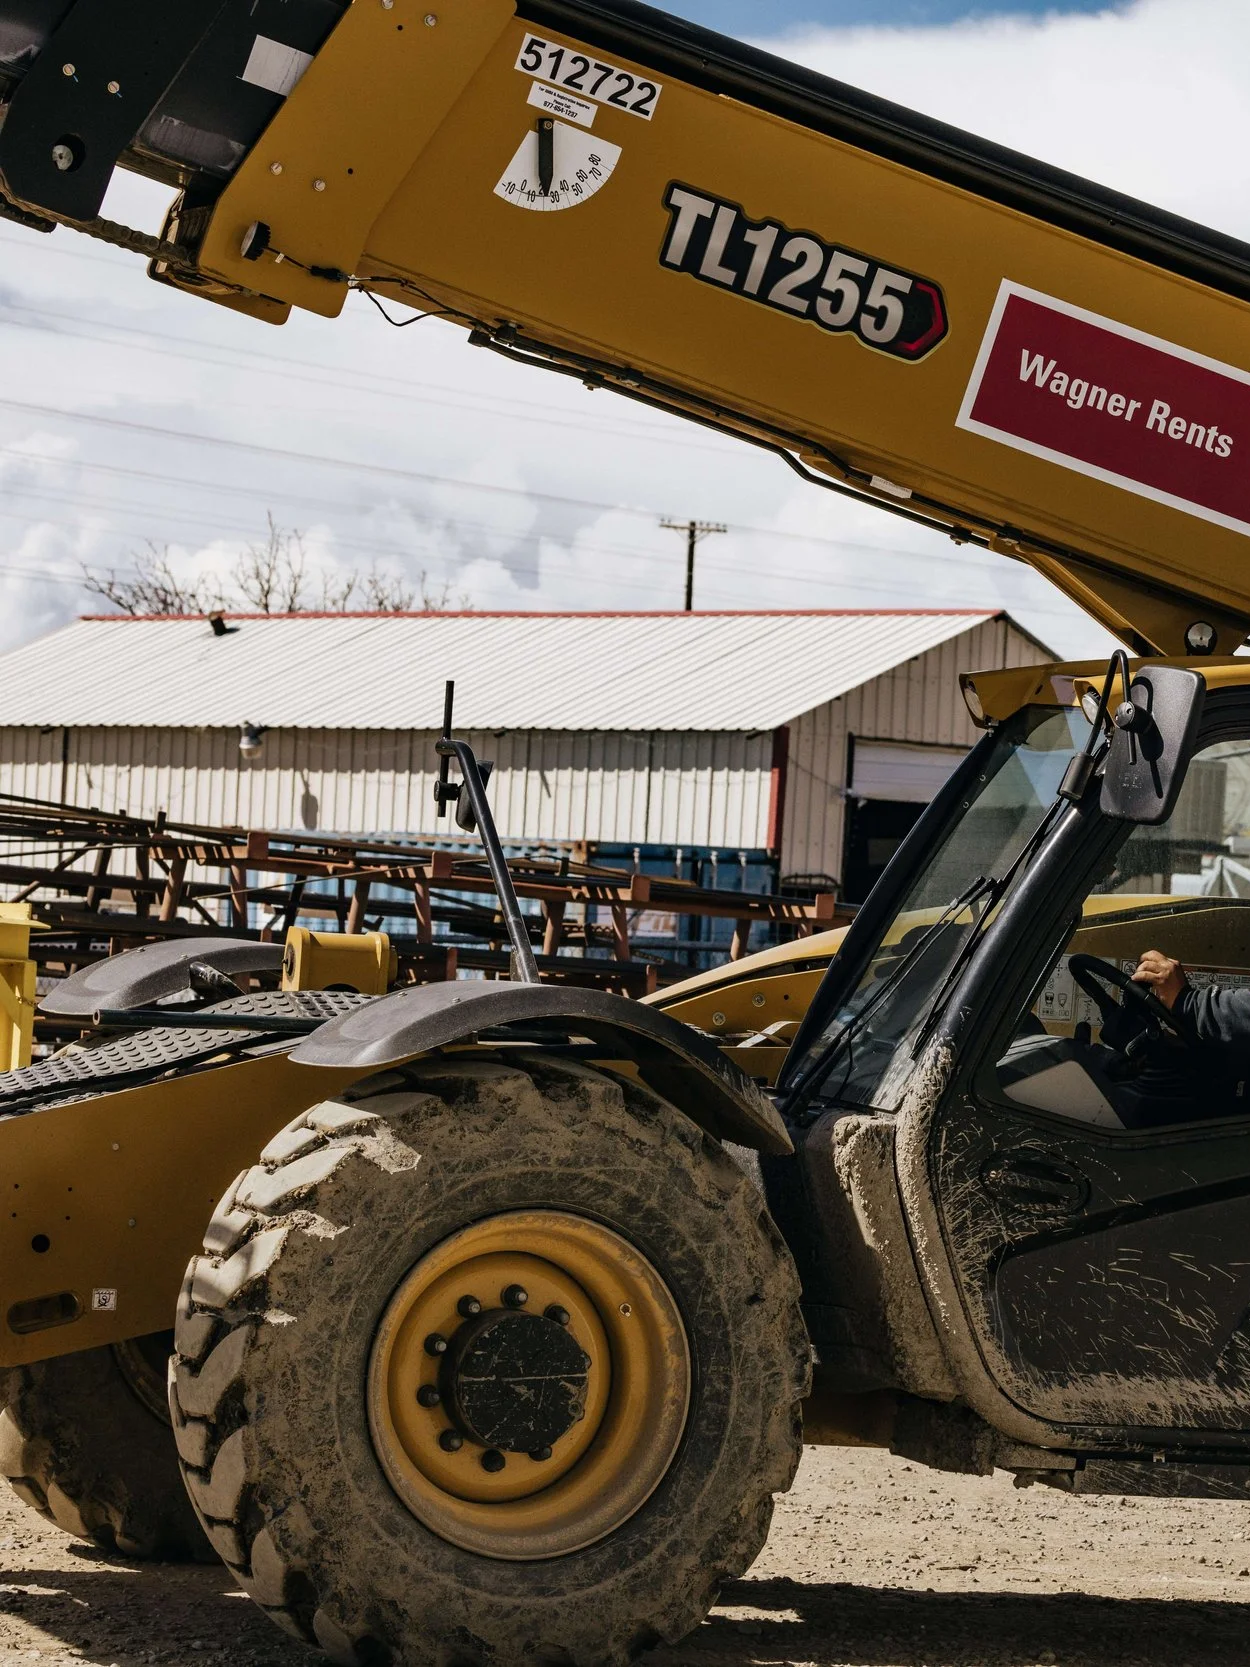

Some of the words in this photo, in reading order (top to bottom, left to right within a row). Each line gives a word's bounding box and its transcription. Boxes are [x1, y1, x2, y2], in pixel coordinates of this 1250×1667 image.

[520, 37, 657, 117] 512722
[588, 154, 601, 165] 80
[576, 169, 588, 182] 60
[589, 167, 602, 180] 70
[520, 180, 527, 191] 0
[560, 180, 569, 192] 40
[571, 182, 583, 196] 50
[527, 190, 535, 202] 10
[550, 190, 560, 203] 30
[665, 188, 913, 343] TL1255
[1019, 348, 1142, 422] Wagner
[1145, 399, 1234, 458] Rents
